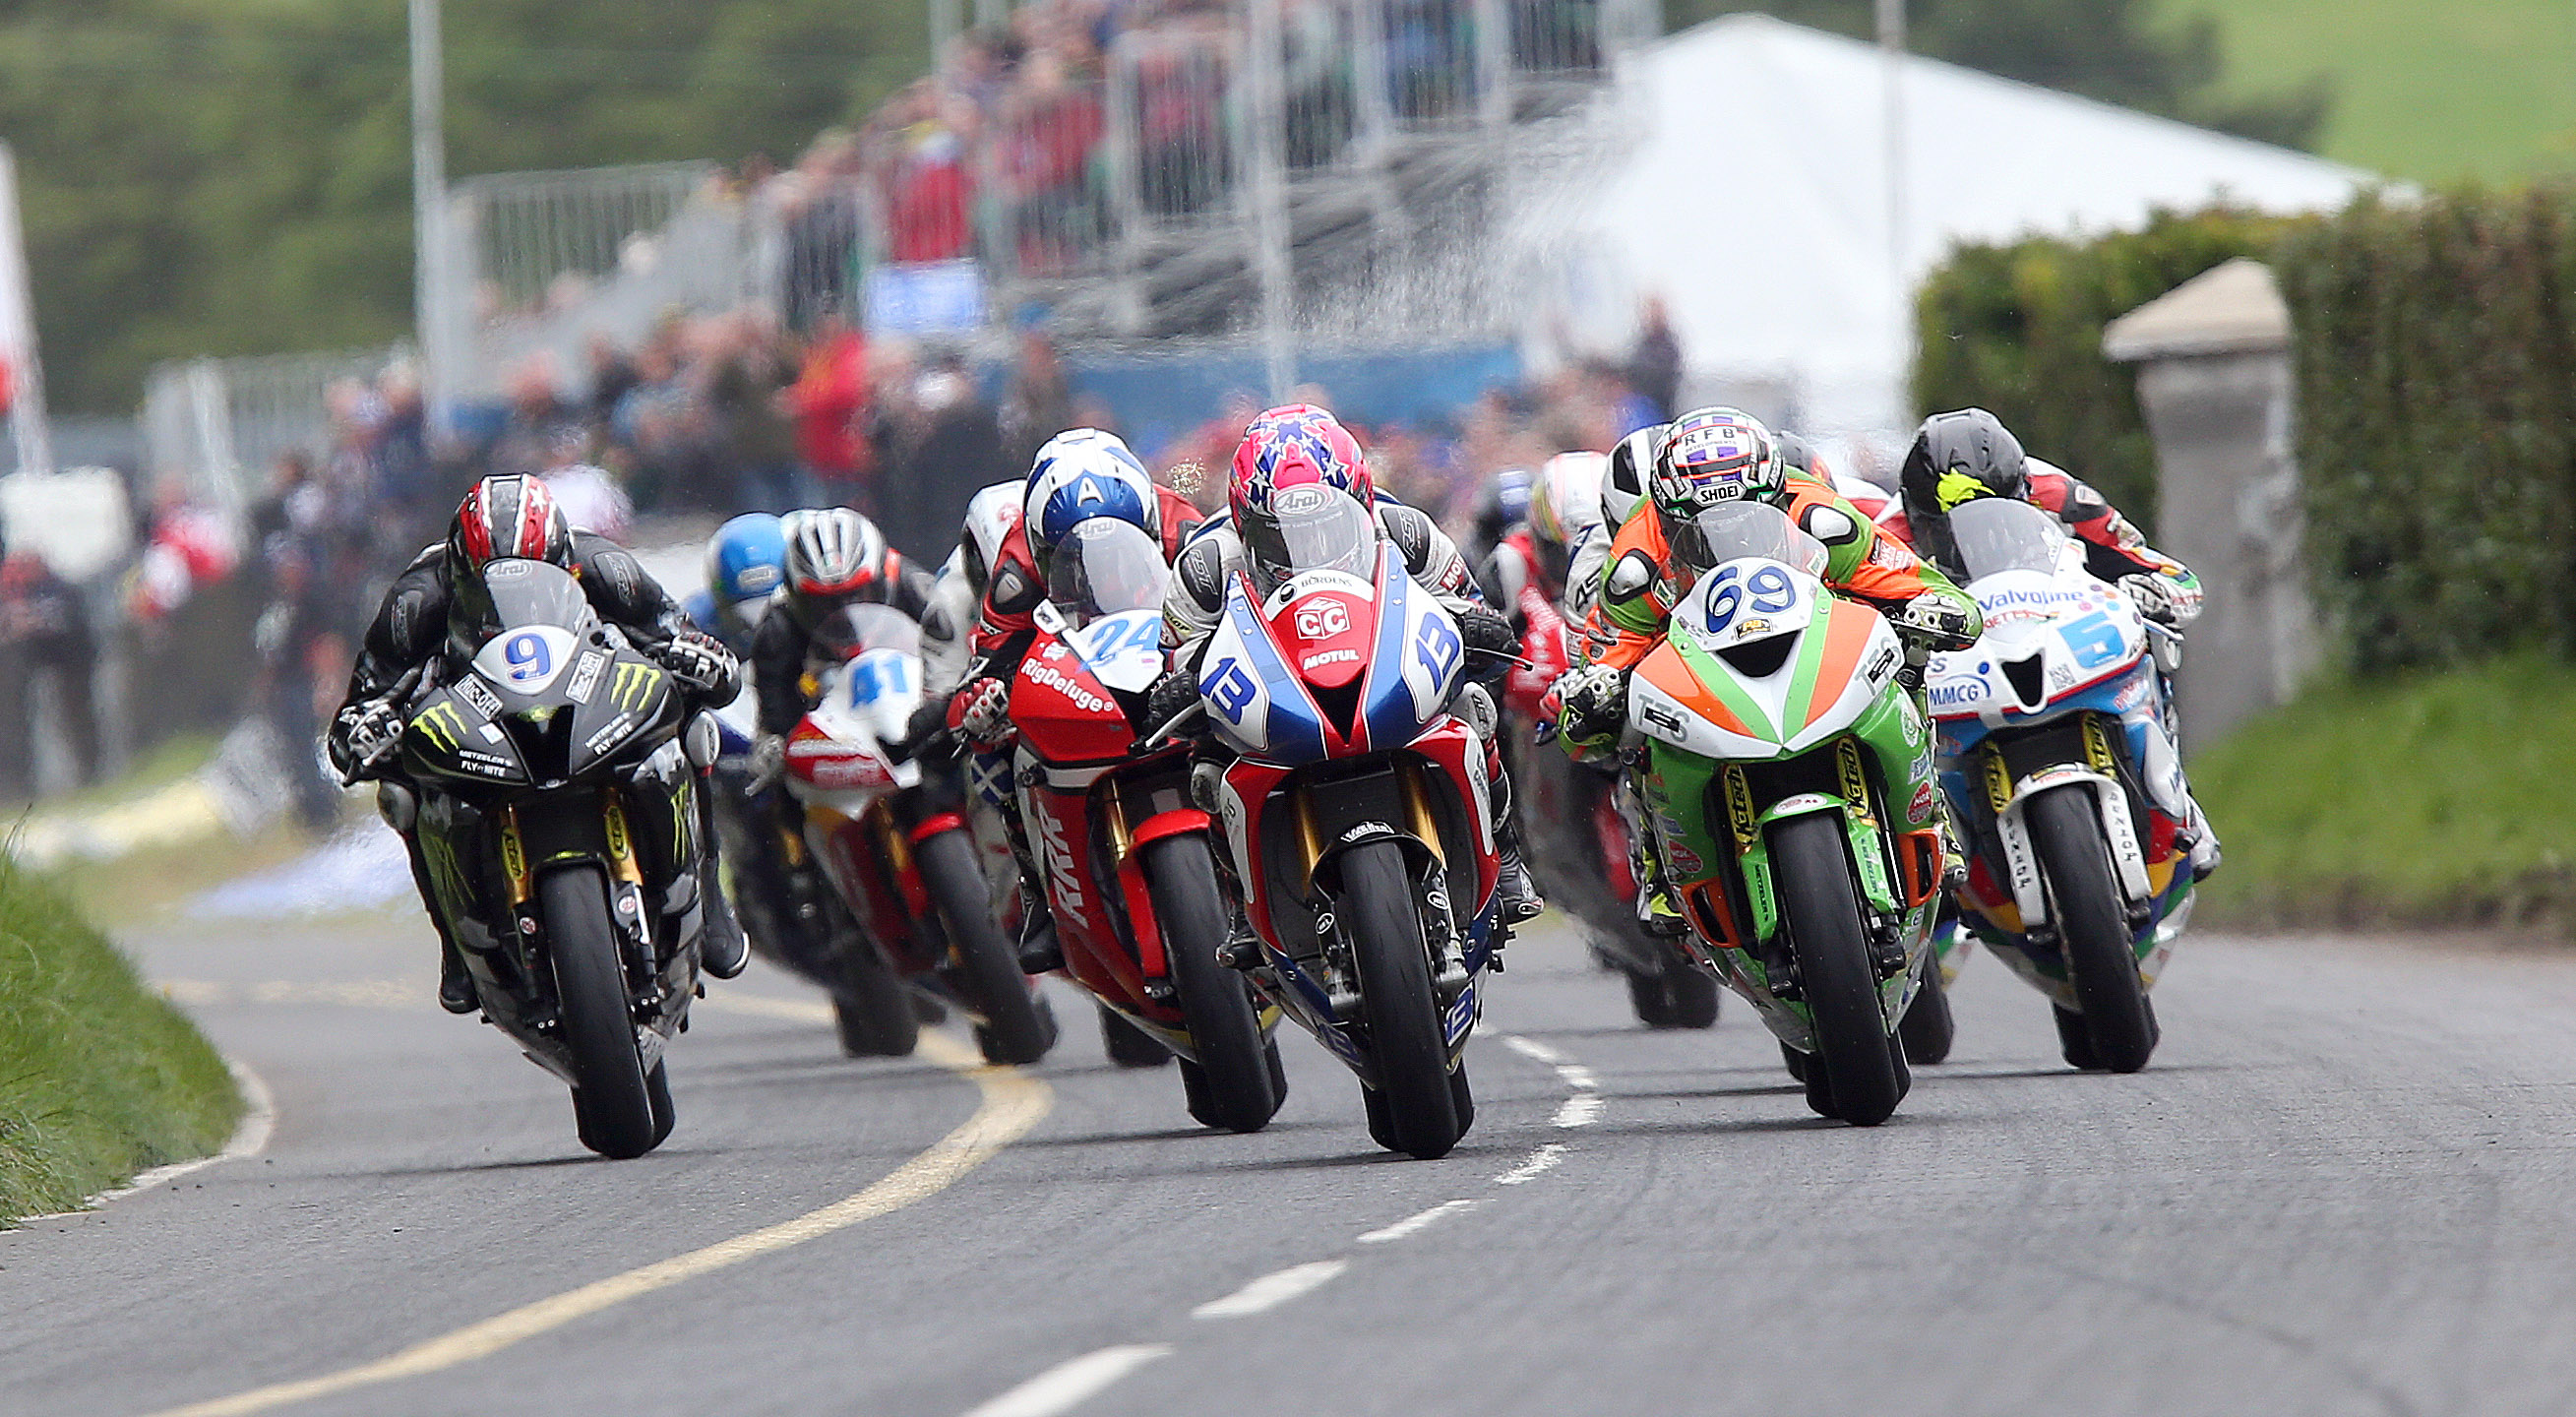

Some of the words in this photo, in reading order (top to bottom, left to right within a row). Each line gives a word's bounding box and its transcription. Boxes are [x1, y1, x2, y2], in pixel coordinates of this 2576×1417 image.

[1278, 492, 1319, 510] Arai
[1700, 485, 1739, 503] SHOEI
[1189, 550, 1218, 596] RST
[1705, 566, 1796, 634] 69
[1979, 589, 2084, 611] Valvoline
[503, 631, 553, 682] 9
[1077, 617, 1161, 672] 24
[1303, 649, 1360, 670] MOTUL
[1416, 612, 1460, 697] 13
[2057, 610, 2126, 669] 5
[851, 656, 908, 708] 41
[1199, 657, 1256, 724] 13
